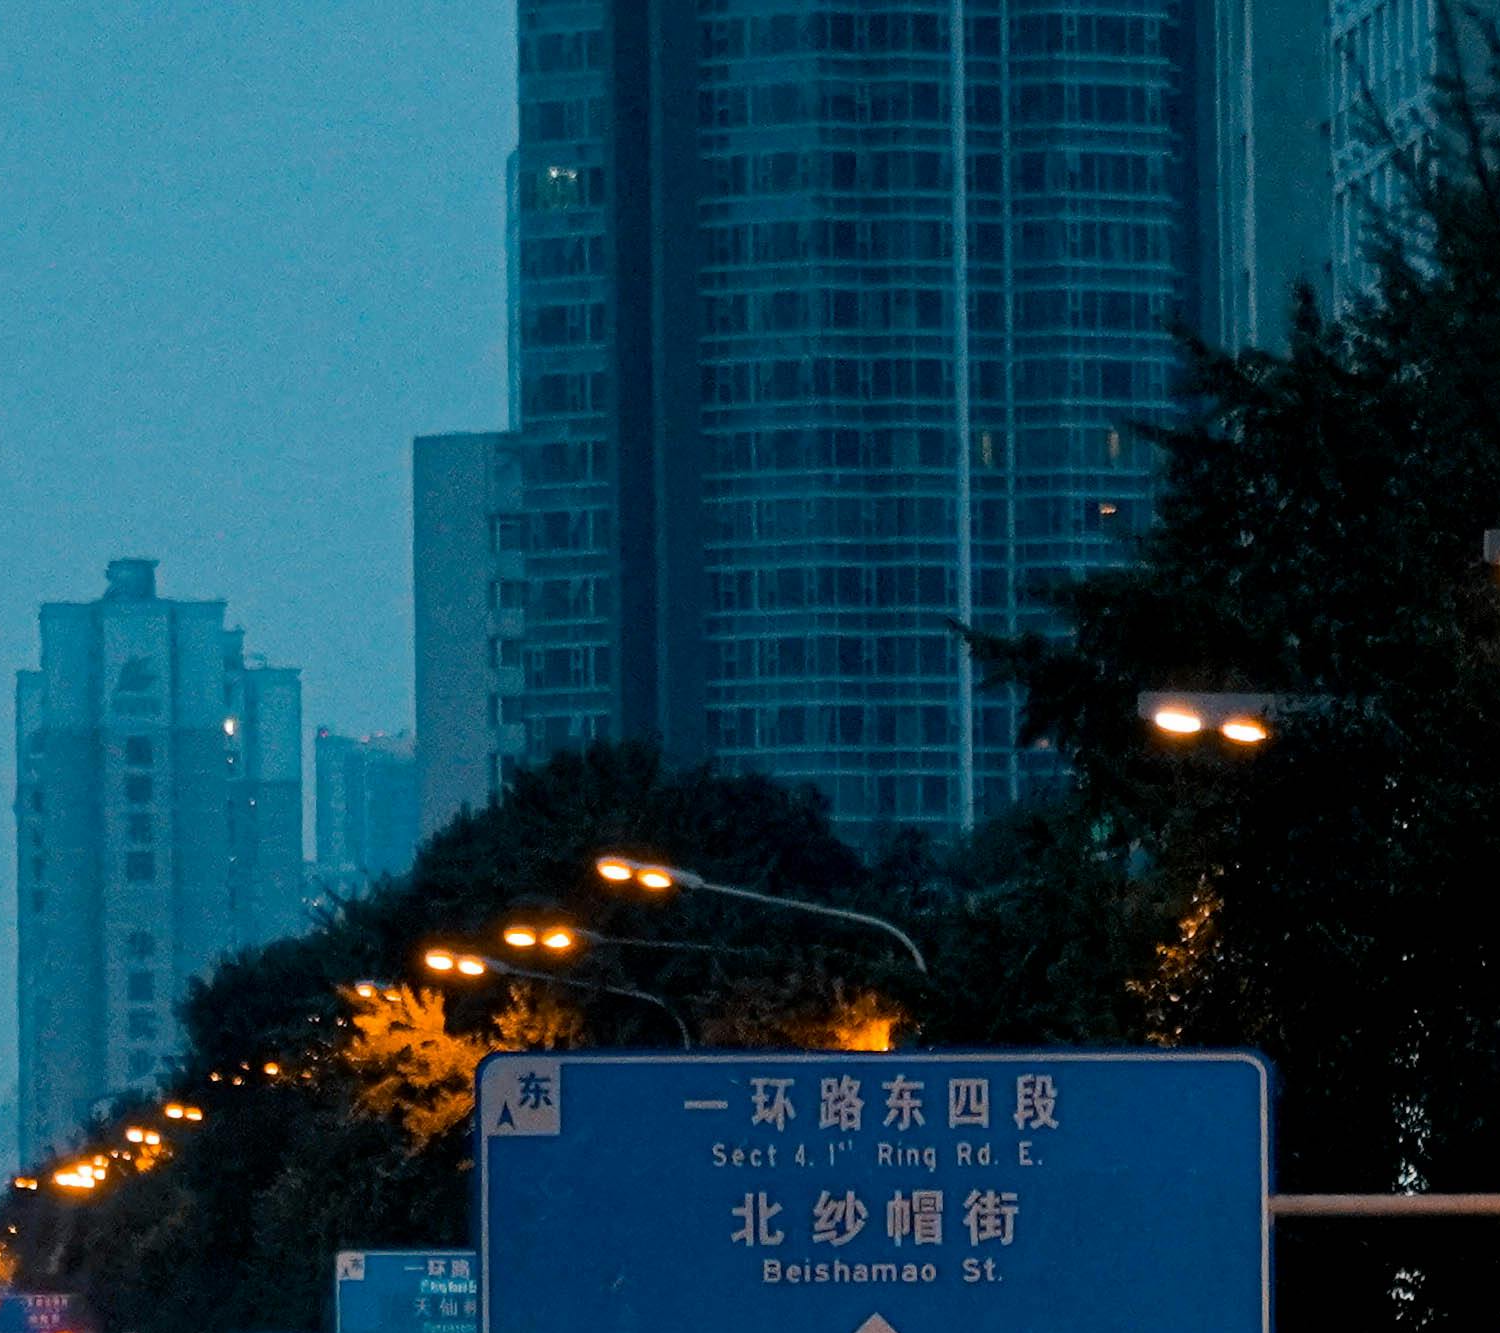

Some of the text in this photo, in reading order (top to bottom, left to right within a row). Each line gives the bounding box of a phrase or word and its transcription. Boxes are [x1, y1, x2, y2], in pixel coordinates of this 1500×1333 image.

[517, 1072, 552, 1109] 东
[684, 1073, 1061, 1132] 一环路东四段
[711, 1143, 777, 1167] Sect
[877, 1143, 937, 1172] Ring
[957, 1142, 999, 1166] Rd.
[1018, 1141, 1044, 1166] E.
[731, 1190, 1019, 1247] 北纱帽街
[762, 1257, 1003, 1283] Beishamao St.
